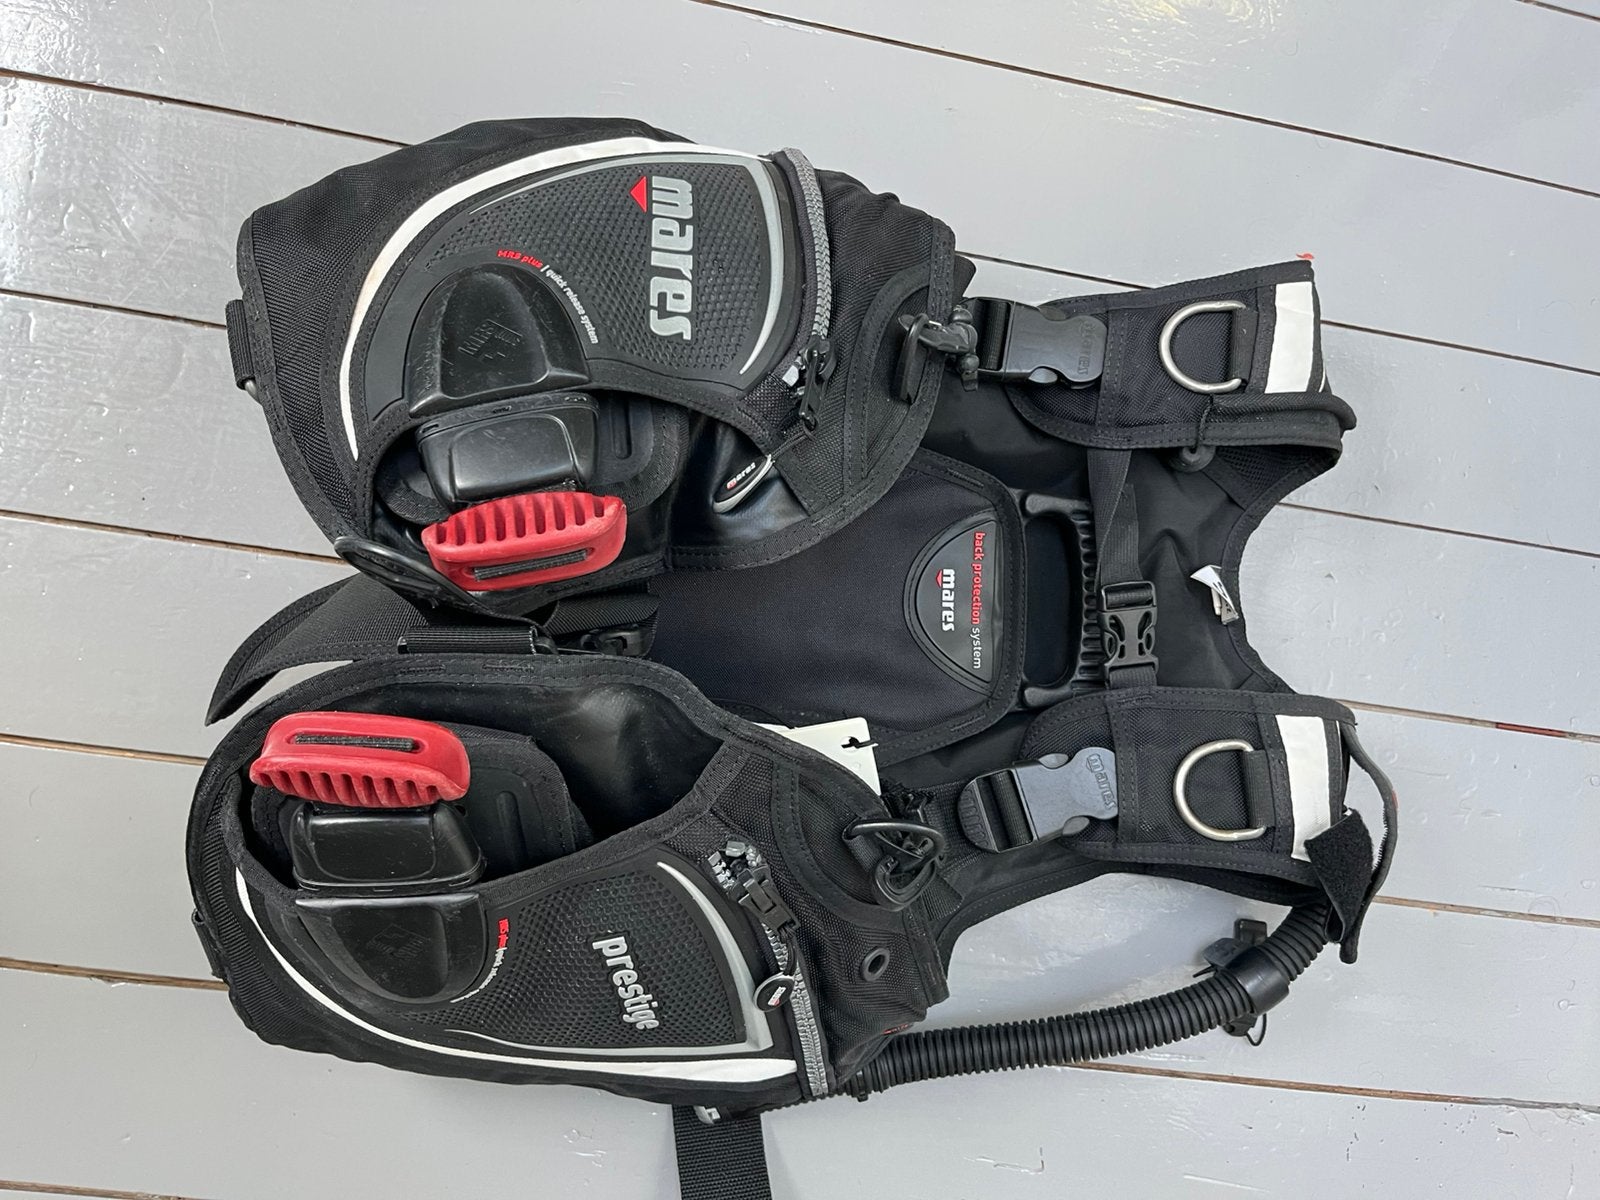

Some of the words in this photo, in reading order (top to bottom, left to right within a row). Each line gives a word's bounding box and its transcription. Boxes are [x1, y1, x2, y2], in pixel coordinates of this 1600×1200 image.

[649, 176, 694, 341] mares
[497, 249, 522, 261] MRS
[521, 256, 544, 270] plus
[546, 269, 568, 289] quick
[563, 287, 586, 315] release
[581, 315, 599, 344] system
[1077, 318, 1097, 376] ares
[974, 531, 986, 561] back
[941, 568, 956, 632] mares
[971, 562, 983, 625] protection
[969, 627, 983, 669] system
[592, 935, 660, 1030] prestige
